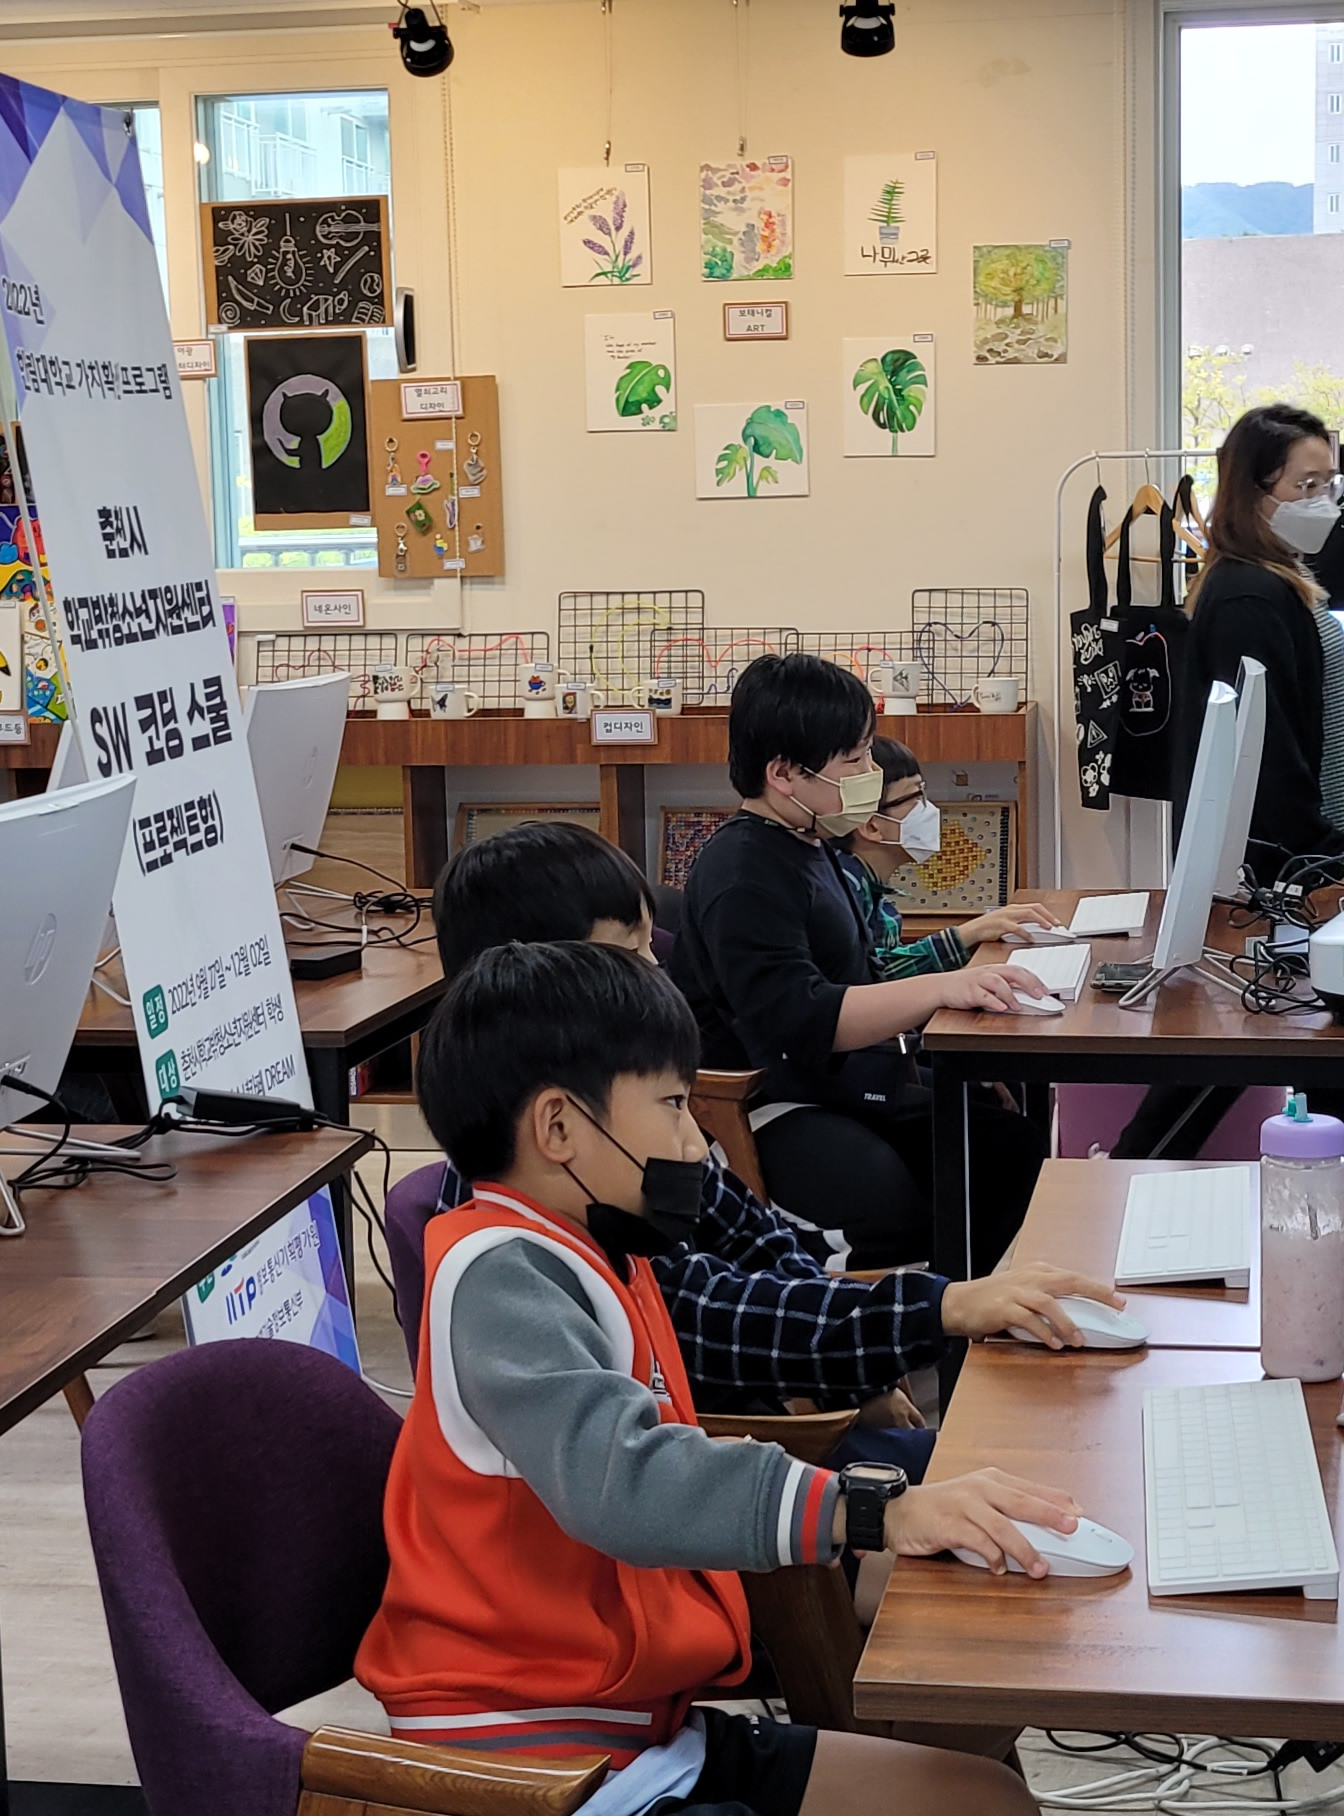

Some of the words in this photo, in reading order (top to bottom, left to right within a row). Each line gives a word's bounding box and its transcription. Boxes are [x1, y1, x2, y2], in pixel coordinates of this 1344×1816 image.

[2, 278, 45, 325] 2022년
[746, 324, 766, 332] ART
[16, 350, 76, 396] 한림대학교
[414, 386, 448, 398] 열쇠고리
[97, 506, 149, 559] 춘천시
[63, 579, 216, 652] 학교밖청소년지원센터
[314, 604, 352, 615] 네온사인
[90, 701, 133, 778] SW
[134, 687, 184, 766] 코딩
[187, 675, 233, 752] 스쿨
[603, 720, 644, 733] 컵디자인
[133, 789, 224, 877] (프로젝트형)
[145, 993, 165, 1030] 일정
[167, 973, 198, 1015] 2022년
[250, 934, 272, 968] 02일
[158, 1057, 178, 1093] 대상
[266, 992, 284, 1025] 학생
[265, 1053, 296, 1091] DREAM
